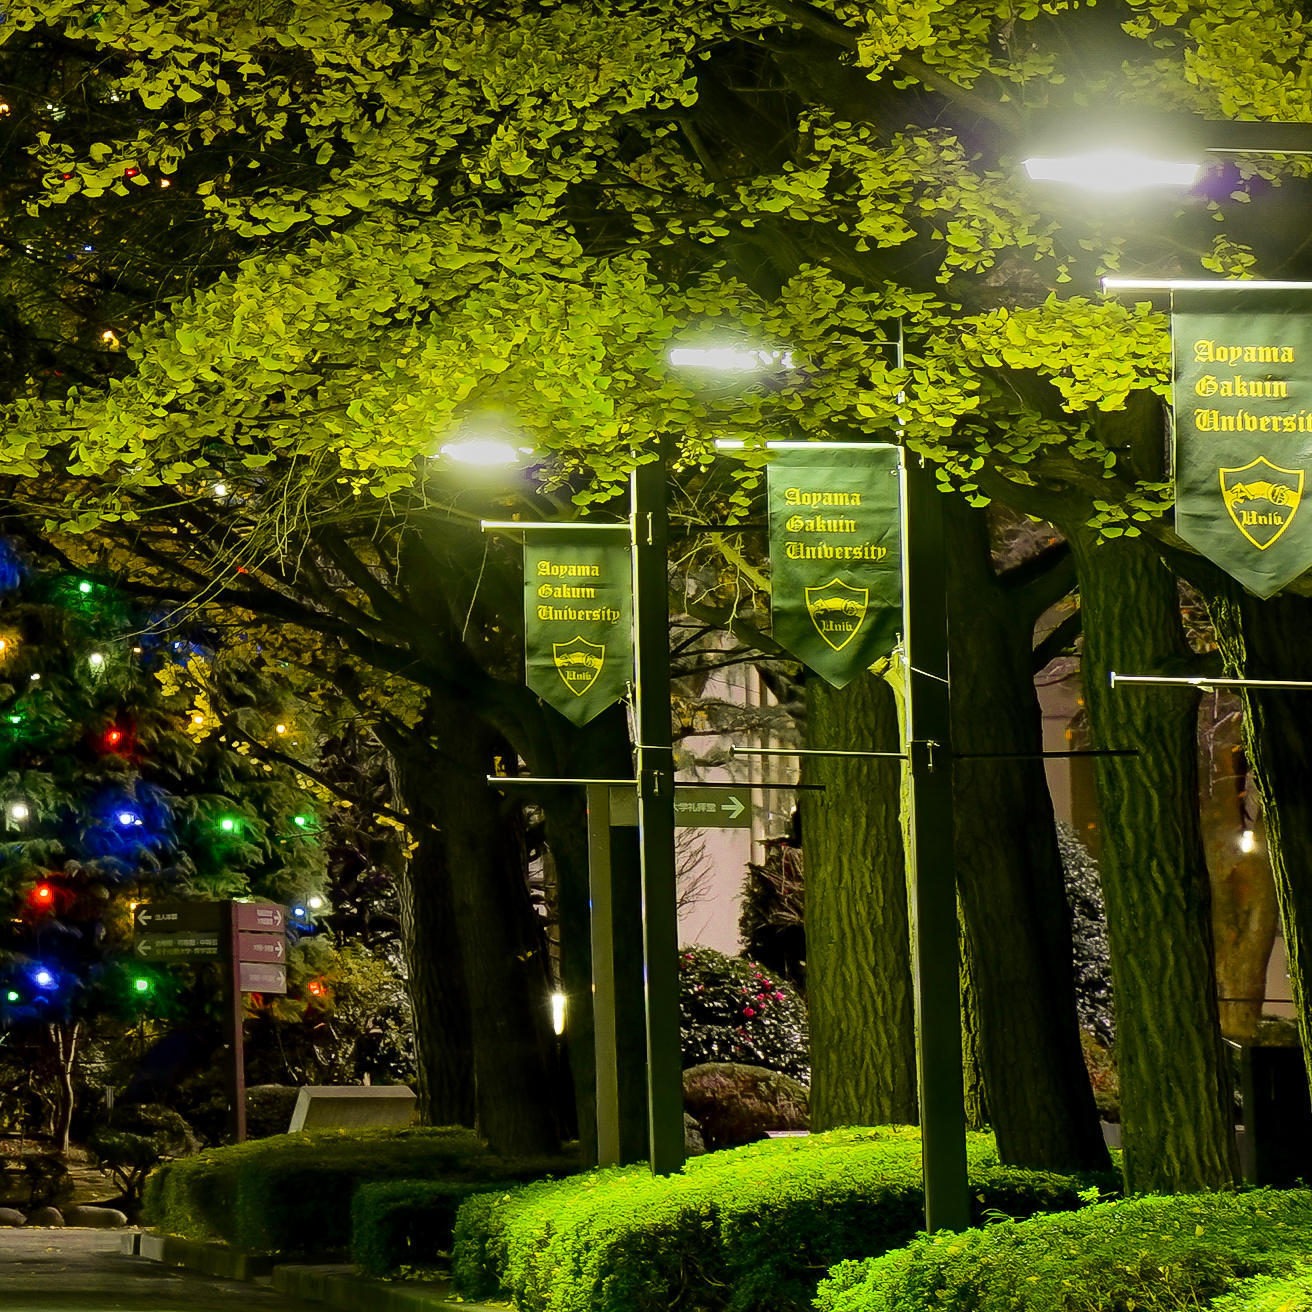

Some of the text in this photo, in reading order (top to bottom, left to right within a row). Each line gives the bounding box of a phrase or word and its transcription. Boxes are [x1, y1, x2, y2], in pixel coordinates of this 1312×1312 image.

[1193, 339, 1295, 367] Aoyama
[1194, 373, 1289, 398] Gakuin
[783, 487, 862, 509] Aoyama
[784, 514, 857, 533] Gakuin
[784, 541, 888, 562] University
[537, 560, 600, 579] Aoyama
[537, 582, 596, 599] Gakuin
[536, 604, 621, 624] University
